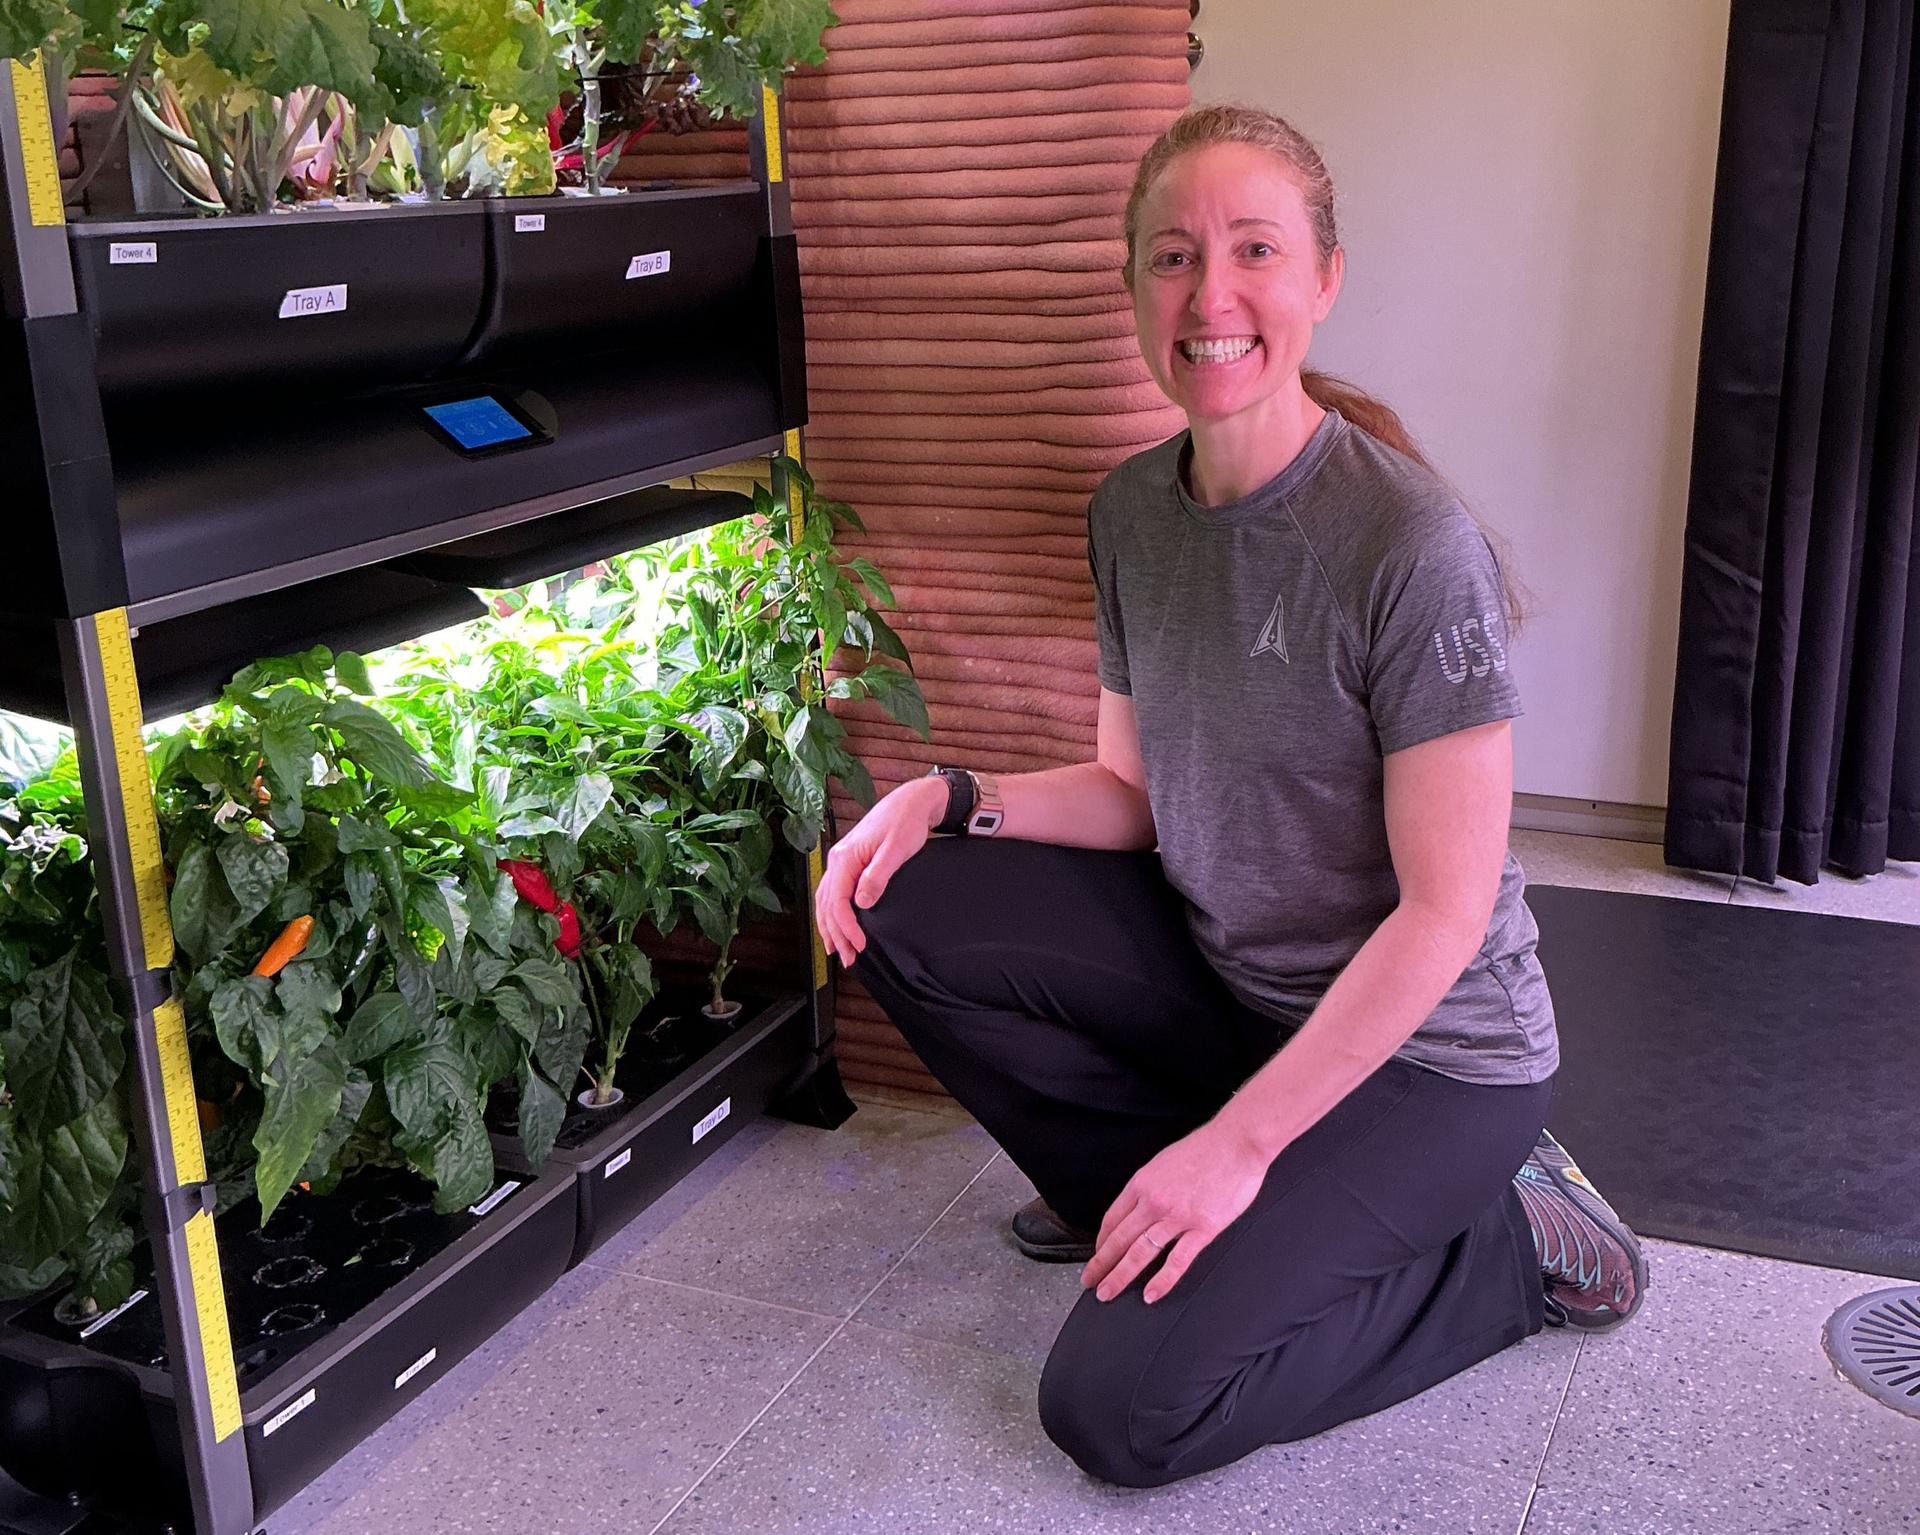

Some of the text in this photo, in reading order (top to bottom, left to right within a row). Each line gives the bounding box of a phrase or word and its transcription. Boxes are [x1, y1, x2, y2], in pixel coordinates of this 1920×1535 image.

[115, 247, 152, 259] Tower 4
[634, 256, 663, 273] Tray B
[292, 290, 336, 312] Tray A
[700, 1114, 718, 1134] Tray
